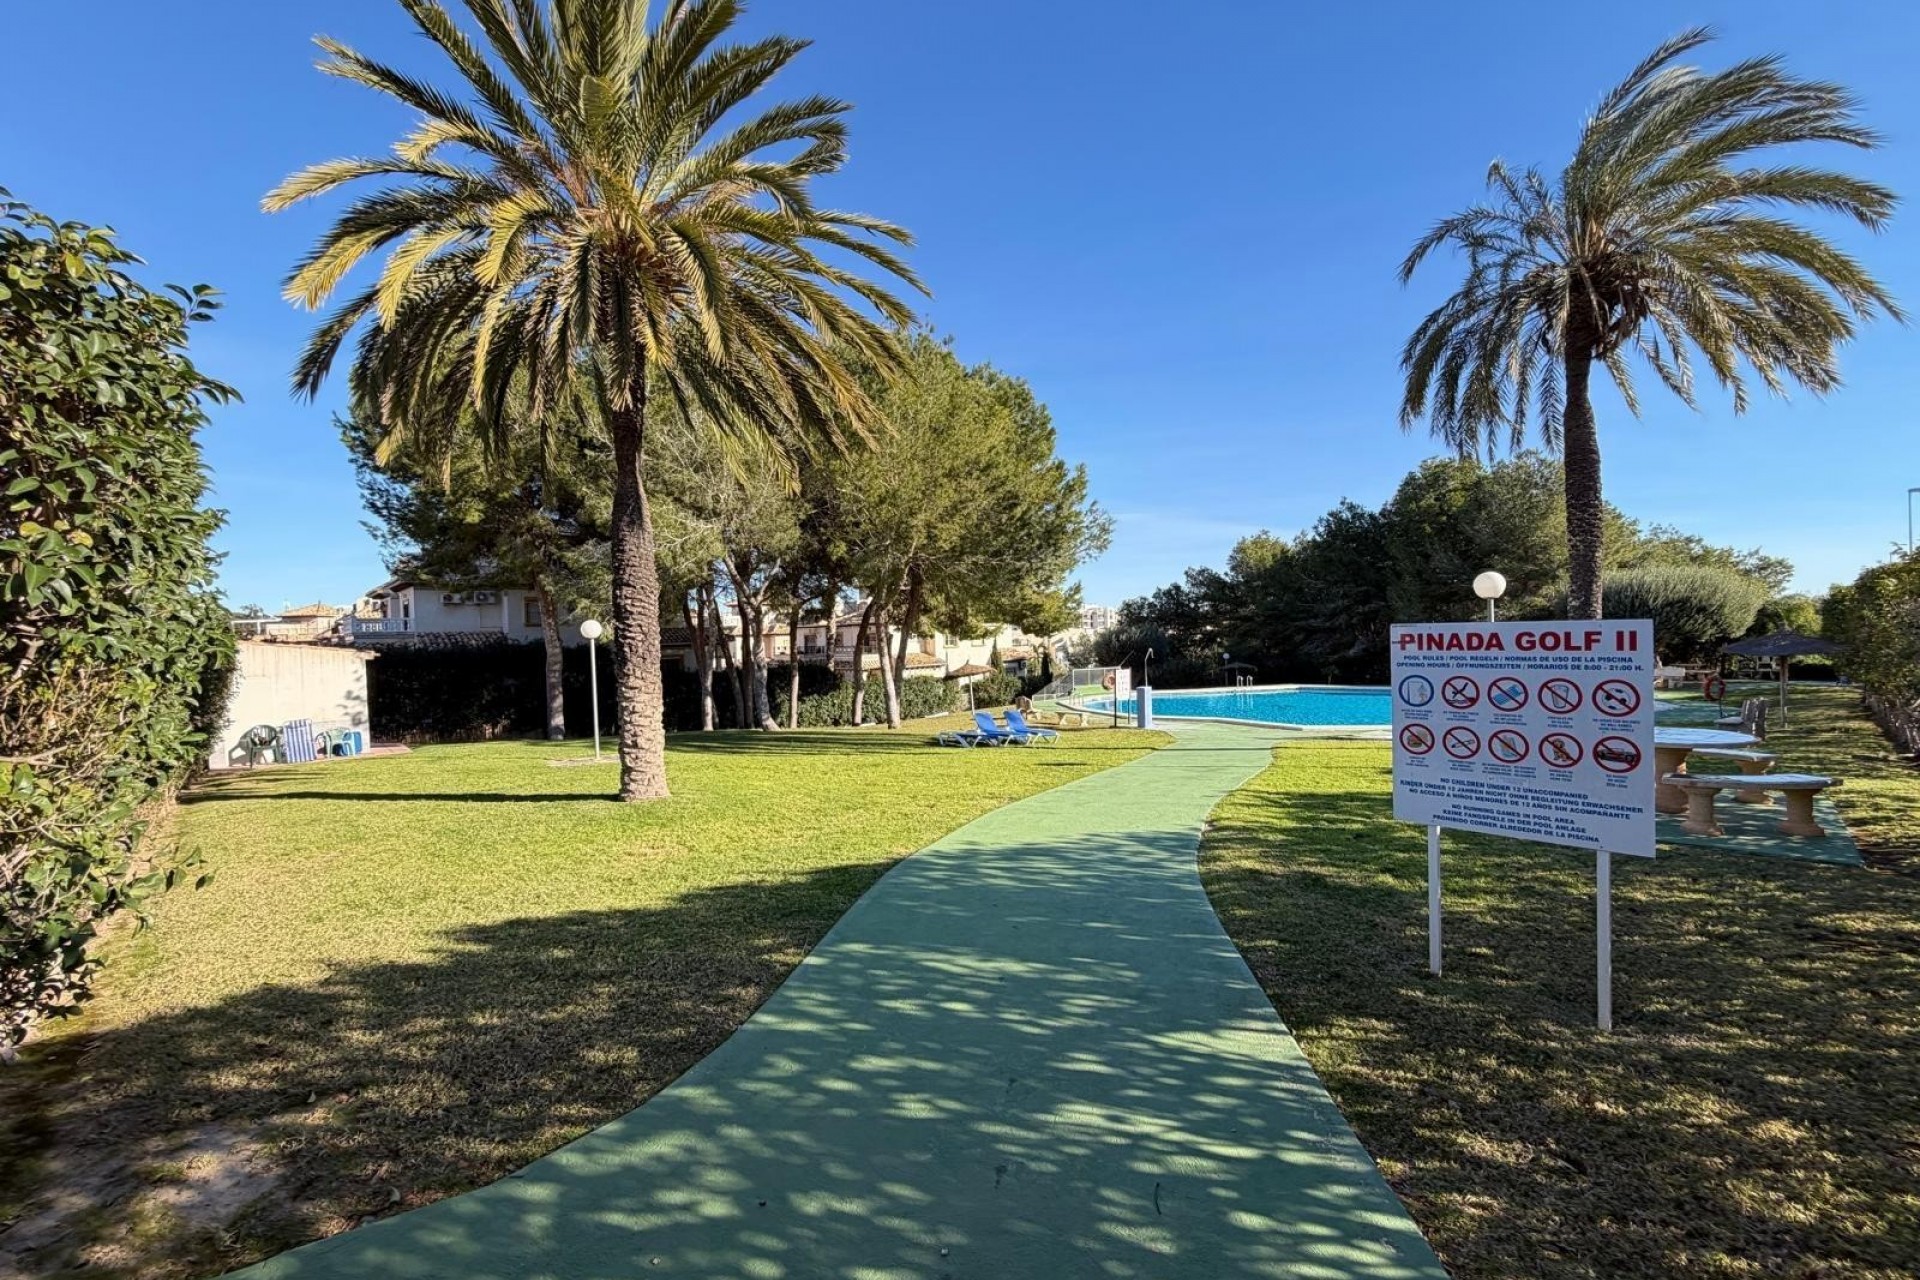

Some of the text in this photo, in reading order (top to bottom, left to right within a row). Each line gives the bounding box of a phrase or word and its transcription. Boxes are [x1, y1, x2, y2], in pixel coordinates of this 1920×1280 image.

[1400, 630, 1638, 651] PINADA GOLF II
[1452, 778, 1484, 788] CHILDREN
[1522, 788, 1588, 800] UNACCOMPANIED
[1457, 786, 1484, 794] JAHREN
[1531, 796, 1580, 806] BEGLEITUNG
[1582, 801, 1644, 814] ERWACHSENER
[1475, 796, 1508, 804] MENORES
[1464, 806, 1494, 814] RUNNING
[1496, 808, 1520, 818] GAMES
[1464, 812, 1506, 822] FANGSPIELE
[1533, 821, 1553, 829] POOL
[1556, 824, 1586, 834] ANLAGE
[1433, 814, 1468, 824] PROHIBIDO
[1470, 819, 1498, 828] CORRER
[1568, 833, 1600, 842] PISCINA
